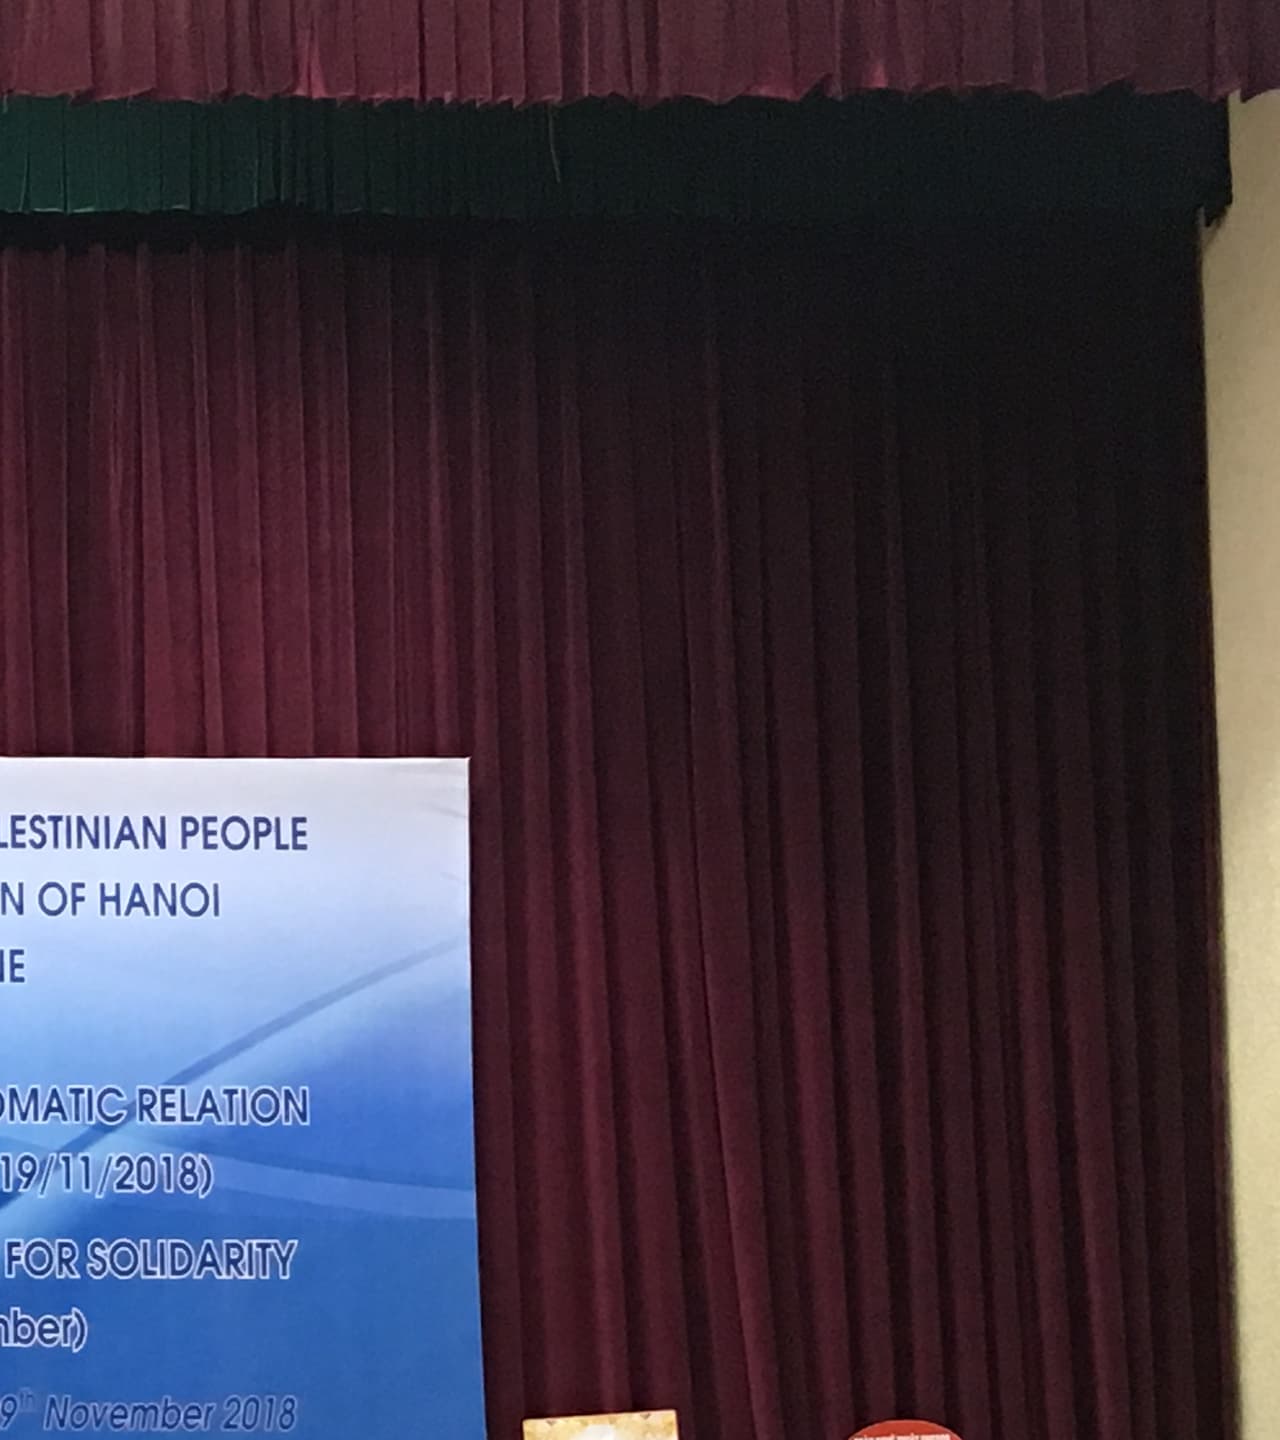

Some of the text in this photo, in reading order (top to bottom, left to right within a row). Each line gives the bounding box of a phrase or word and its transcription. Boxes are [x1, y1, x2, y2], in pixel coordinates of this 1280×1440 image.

[180, 813, 308, 851] PEOPLE
[40, 881, 85, 918] OF
[99, 881, 221, 918] HANOI
[137, 1085, 310, 1126] RELATION
[0, 1152, 214, 1197] 19/11/2018)
[4, 1239, 80, 1279] FOR
[86, 1239, 298, 1279] SOLIDARITY
[43, 1396, 215, 1431] November
[222, 1395, 296, 1431] 2018
